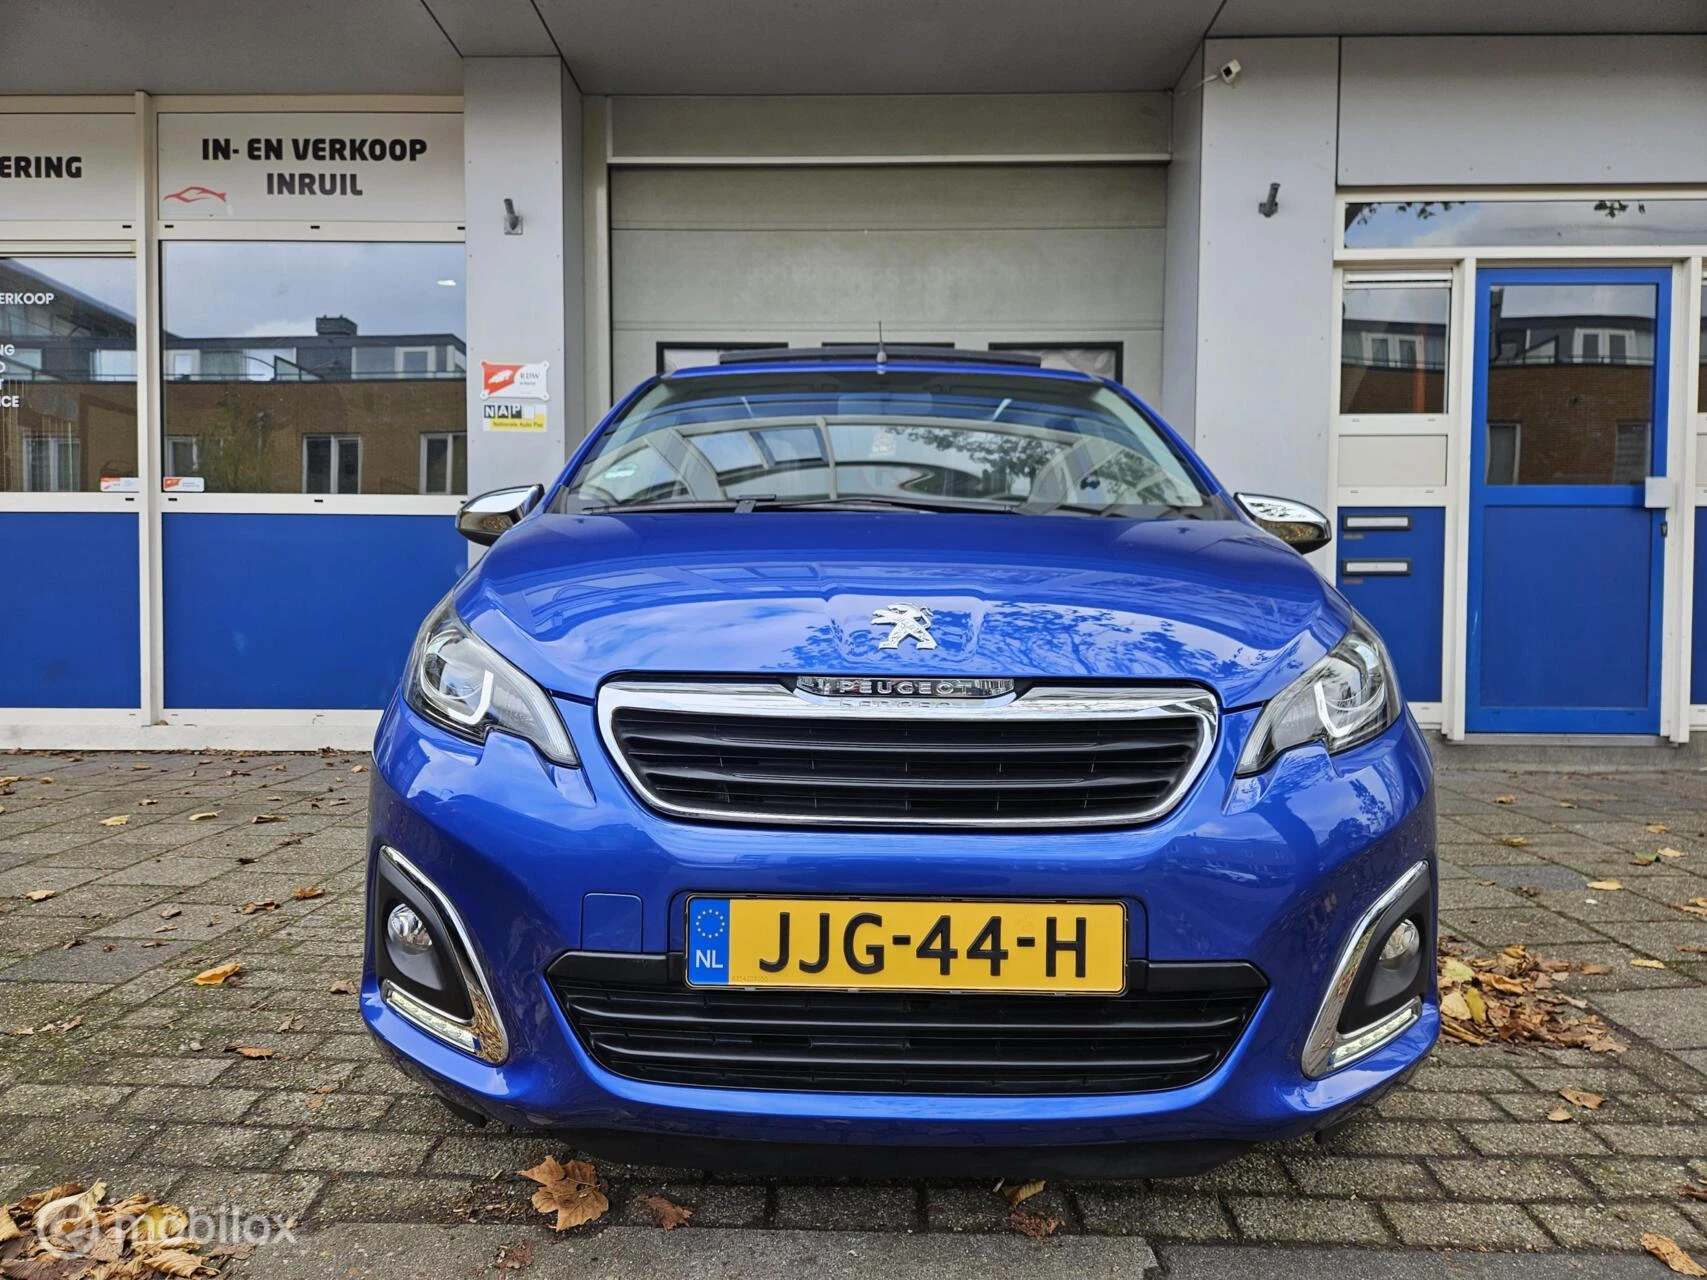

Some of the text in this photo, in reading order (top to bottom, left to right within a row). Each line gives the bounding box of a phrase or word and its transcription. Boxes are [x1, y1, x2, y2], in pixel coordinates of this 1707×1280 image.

[202, 138, 427, 162] IN- EN VERKOOP
[0, 155, 82, 179] ERING
[266, 173, 363, 196] INRUIL
[484, 404, 522, 419] NAP
[840, 681, 972, 695] PEUGEOT
[759, 911, 1087, 979] JJG-44-H
[695, 949, 724, 970] NL
